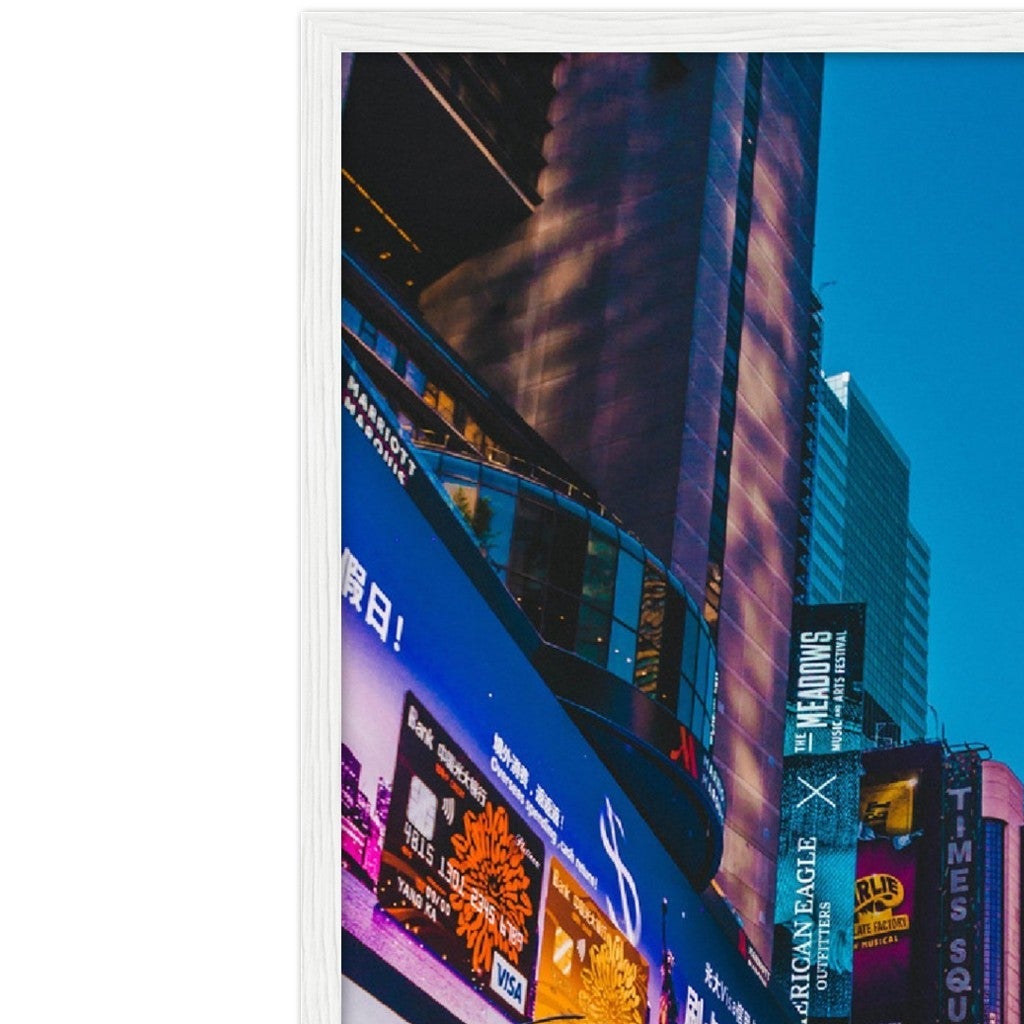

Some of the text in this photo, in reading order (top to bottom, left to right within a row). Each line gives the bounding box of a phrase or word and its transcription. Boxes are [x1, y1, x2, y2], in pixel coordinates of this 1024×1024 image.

[347, 375, 416, 475] MARRIOTT
[832, 677, 846, 702] ARTS
[834, 630, 848, 674] FESTIVAL
[795, 631, 833, 753] THE MEADOWS
[831, 719, 843, 751] MUSIC
[795, 836, 817, 915] EAGLE
[946, 786, 972, 921] TIMES
[497, 962, 523, 1004] VISA
[816, 901, 832, 991] OUTFITTERS
